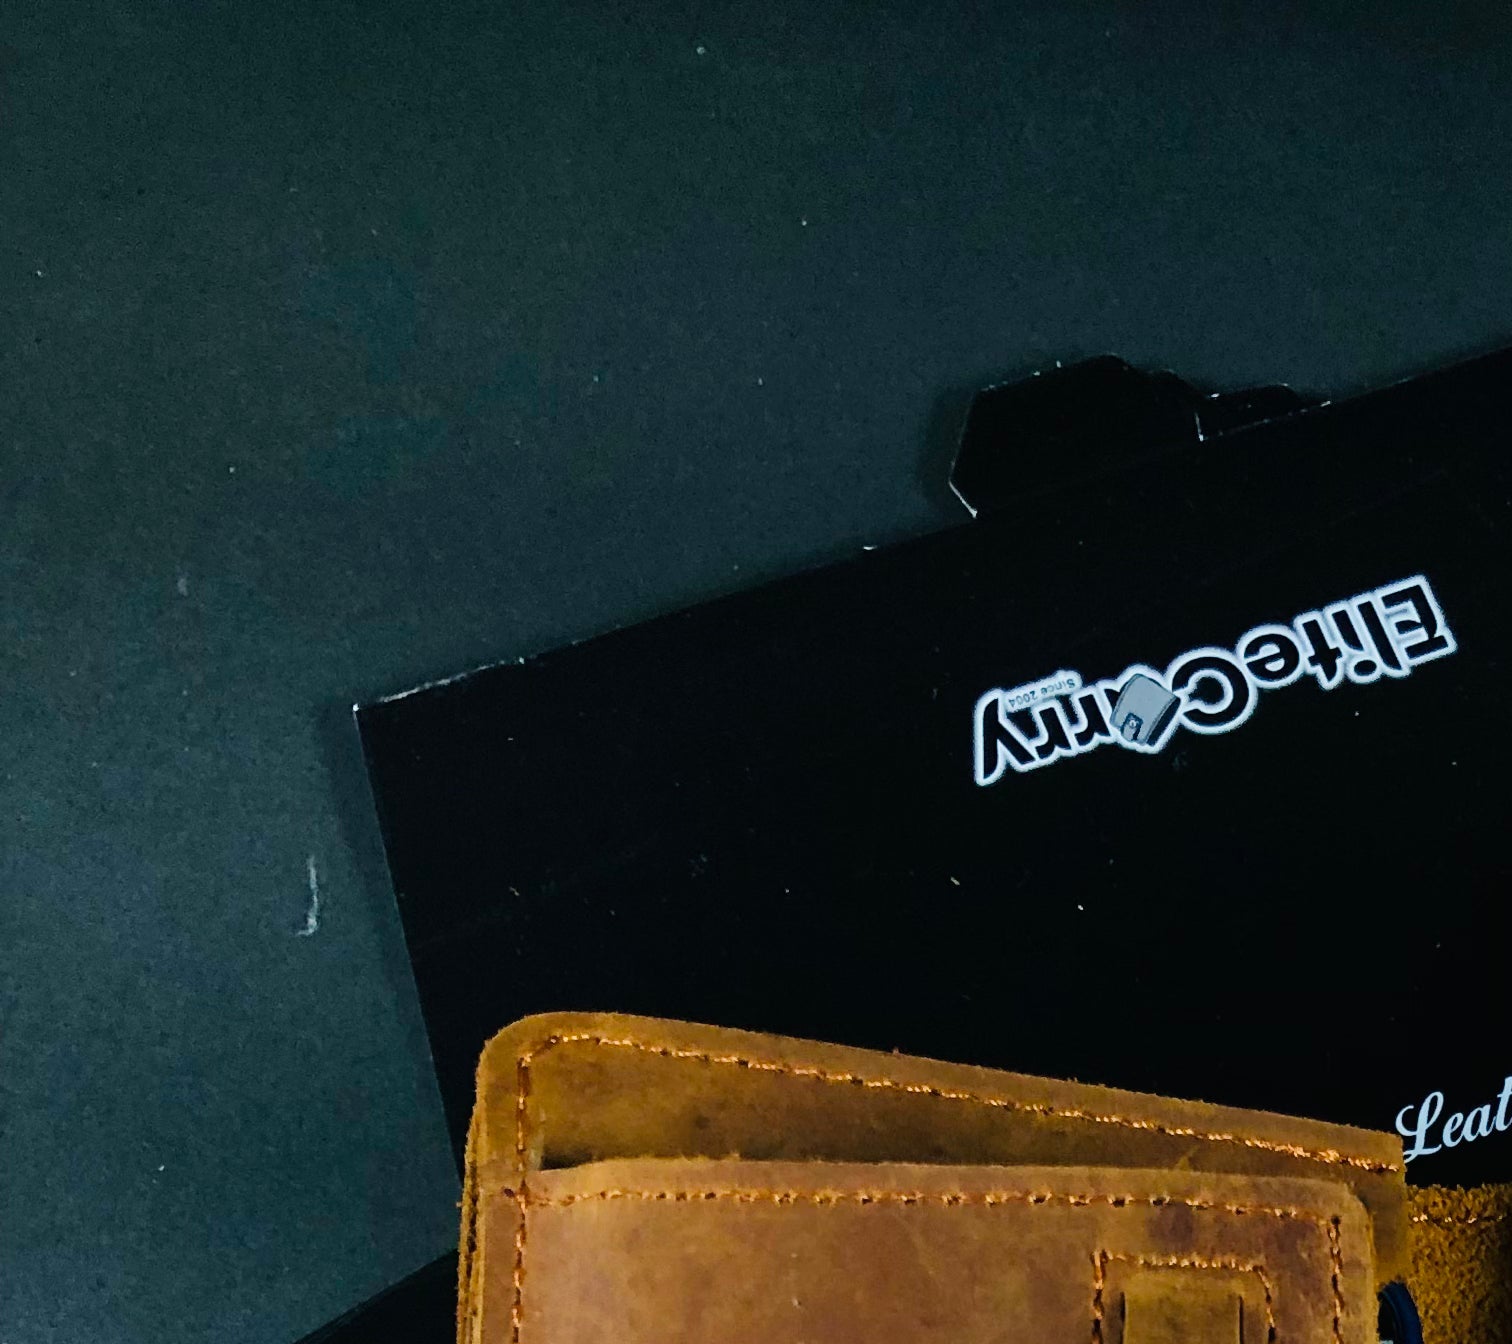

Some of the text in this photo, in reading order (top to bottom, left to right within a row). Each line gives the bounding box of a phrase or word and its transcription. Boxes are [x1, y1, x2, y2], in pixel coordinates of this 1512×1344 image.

[978, 577, 1454, 785] EliteCrry
[1007, 677, 1077, 710] Since 2004
